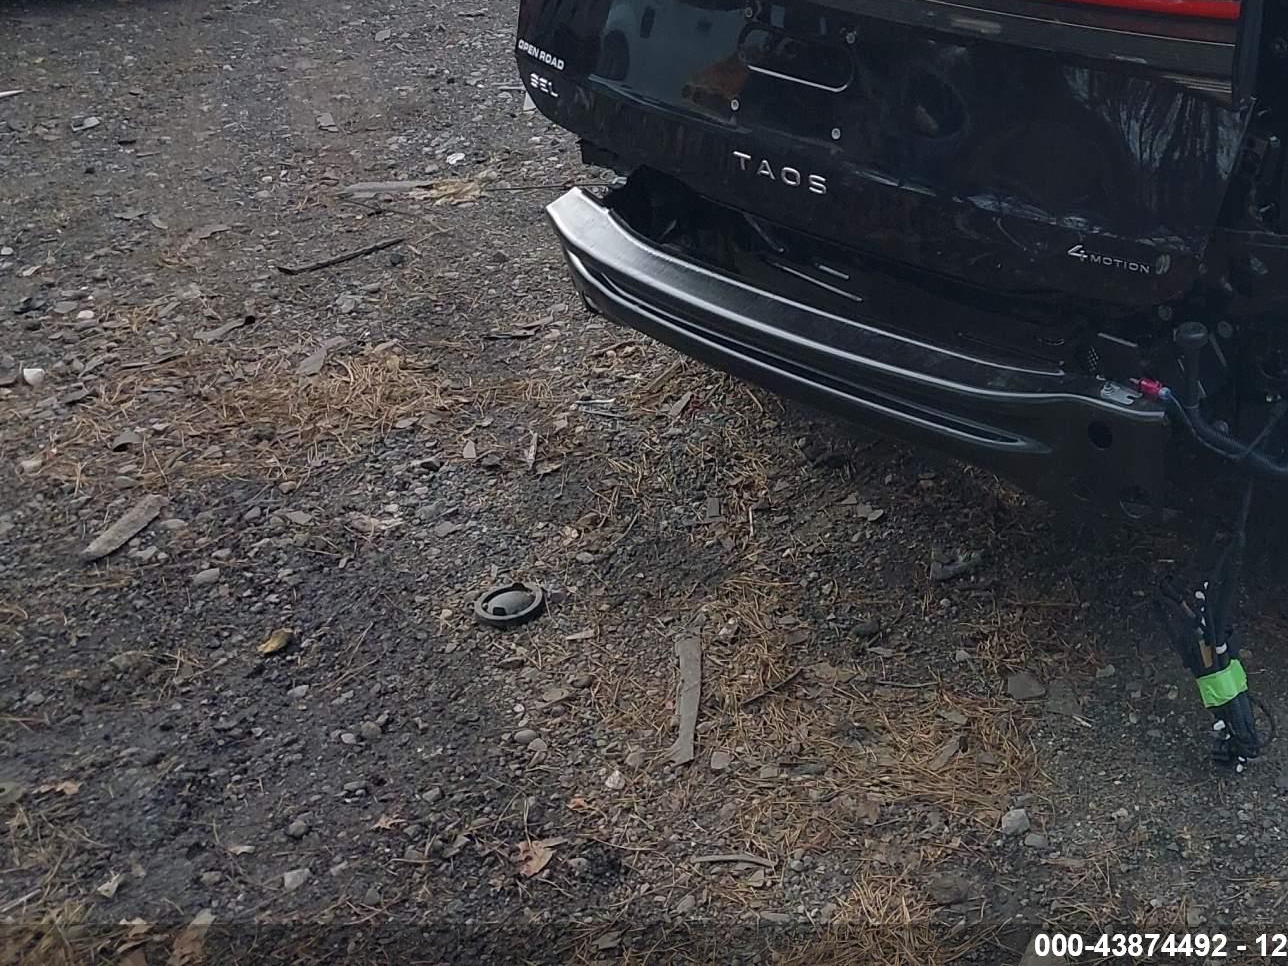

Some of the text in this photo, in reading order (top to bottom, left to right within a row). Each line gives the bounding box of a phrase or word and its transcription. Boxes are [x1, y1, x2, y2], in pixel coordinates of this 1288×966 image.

[518, 38, 565, 71] OPEN ROAD
[530, 73, 559, 97] SEL
[732, 150, 827, 194] TAOS
